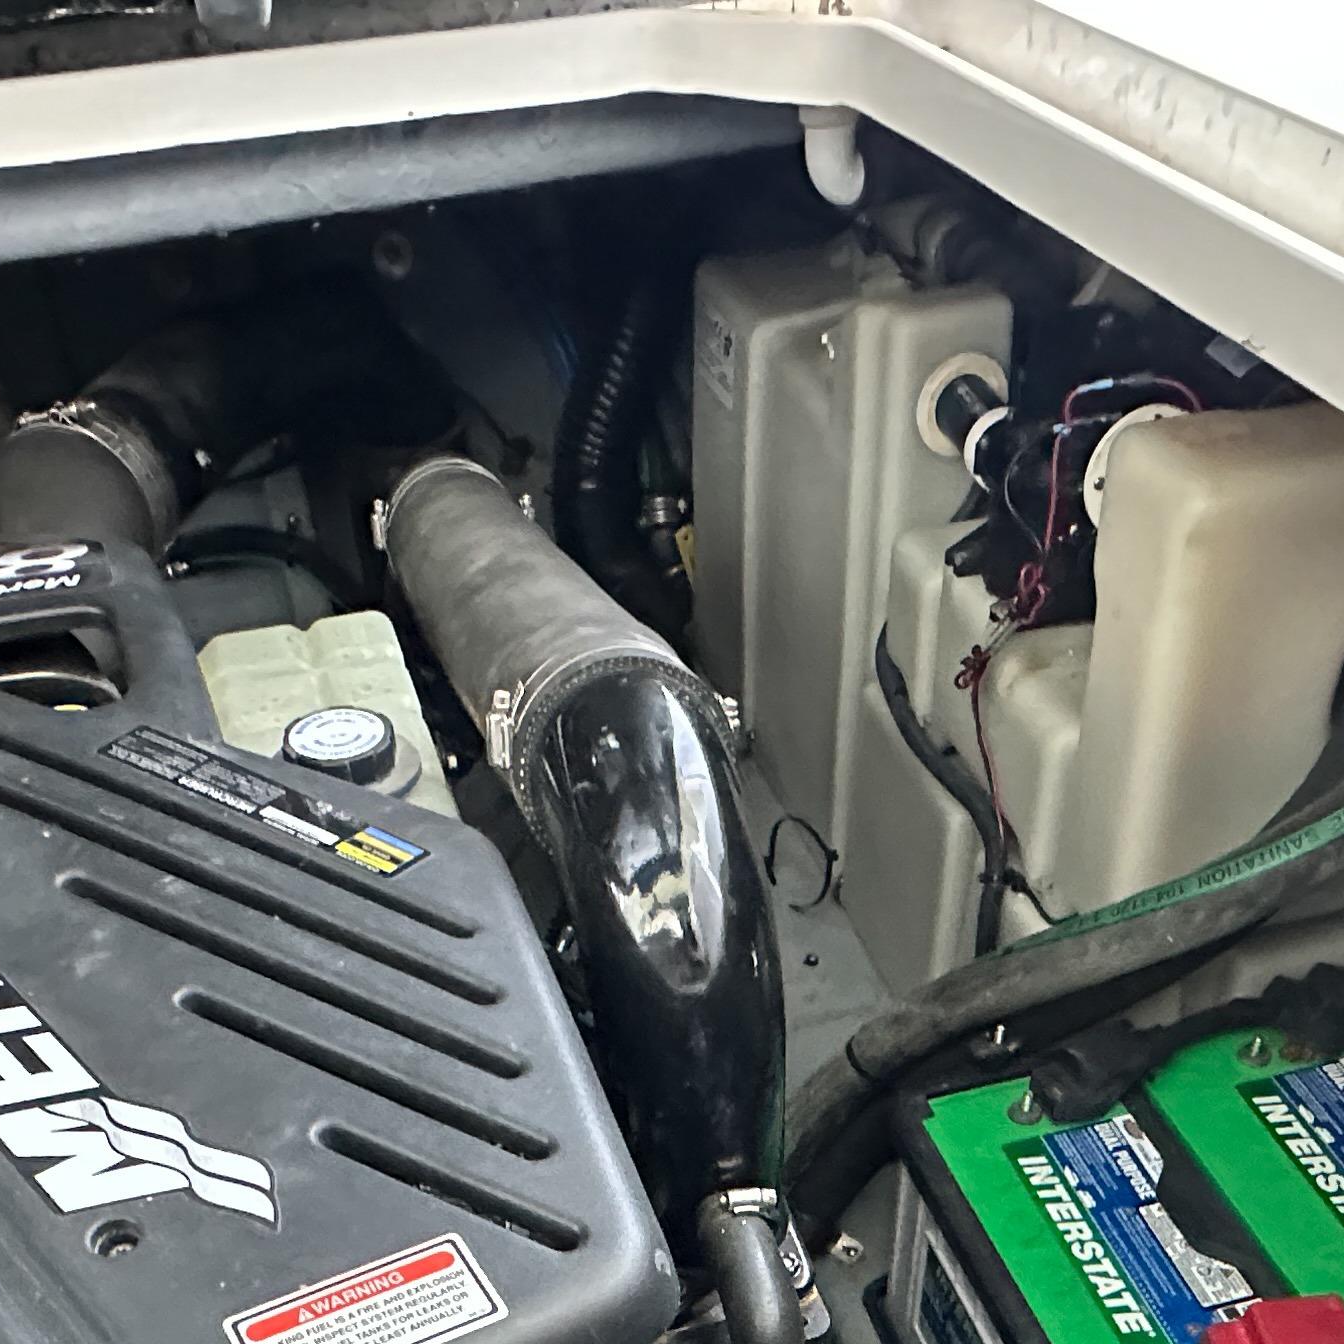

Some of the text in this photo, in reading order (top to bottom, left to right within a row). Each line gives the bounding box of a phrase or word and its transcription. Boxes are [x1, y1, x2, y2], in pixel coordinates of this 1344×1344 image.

[1111, 1149, 1156, 1200] PURPOSE
[1017, 1154, 1151, 1334] INTERSTATE
[305, 1319, 332, 1337] FUEL
[334, 1314, 345, 1325] IS
[347, 1310, 355, 1320] A
[382, 1291, 405, 1306] AND
[310, 1269, 404, 1315] WARNING
[354, 1321, 391, 1341] TANKS
[392, 1311, 414, 1326] FOR
[416, 1297, 451, 1317] LEAKS
[452, 1290, 468, 1302] OR
[360, 1303, 403, 1326] SYSTEM
